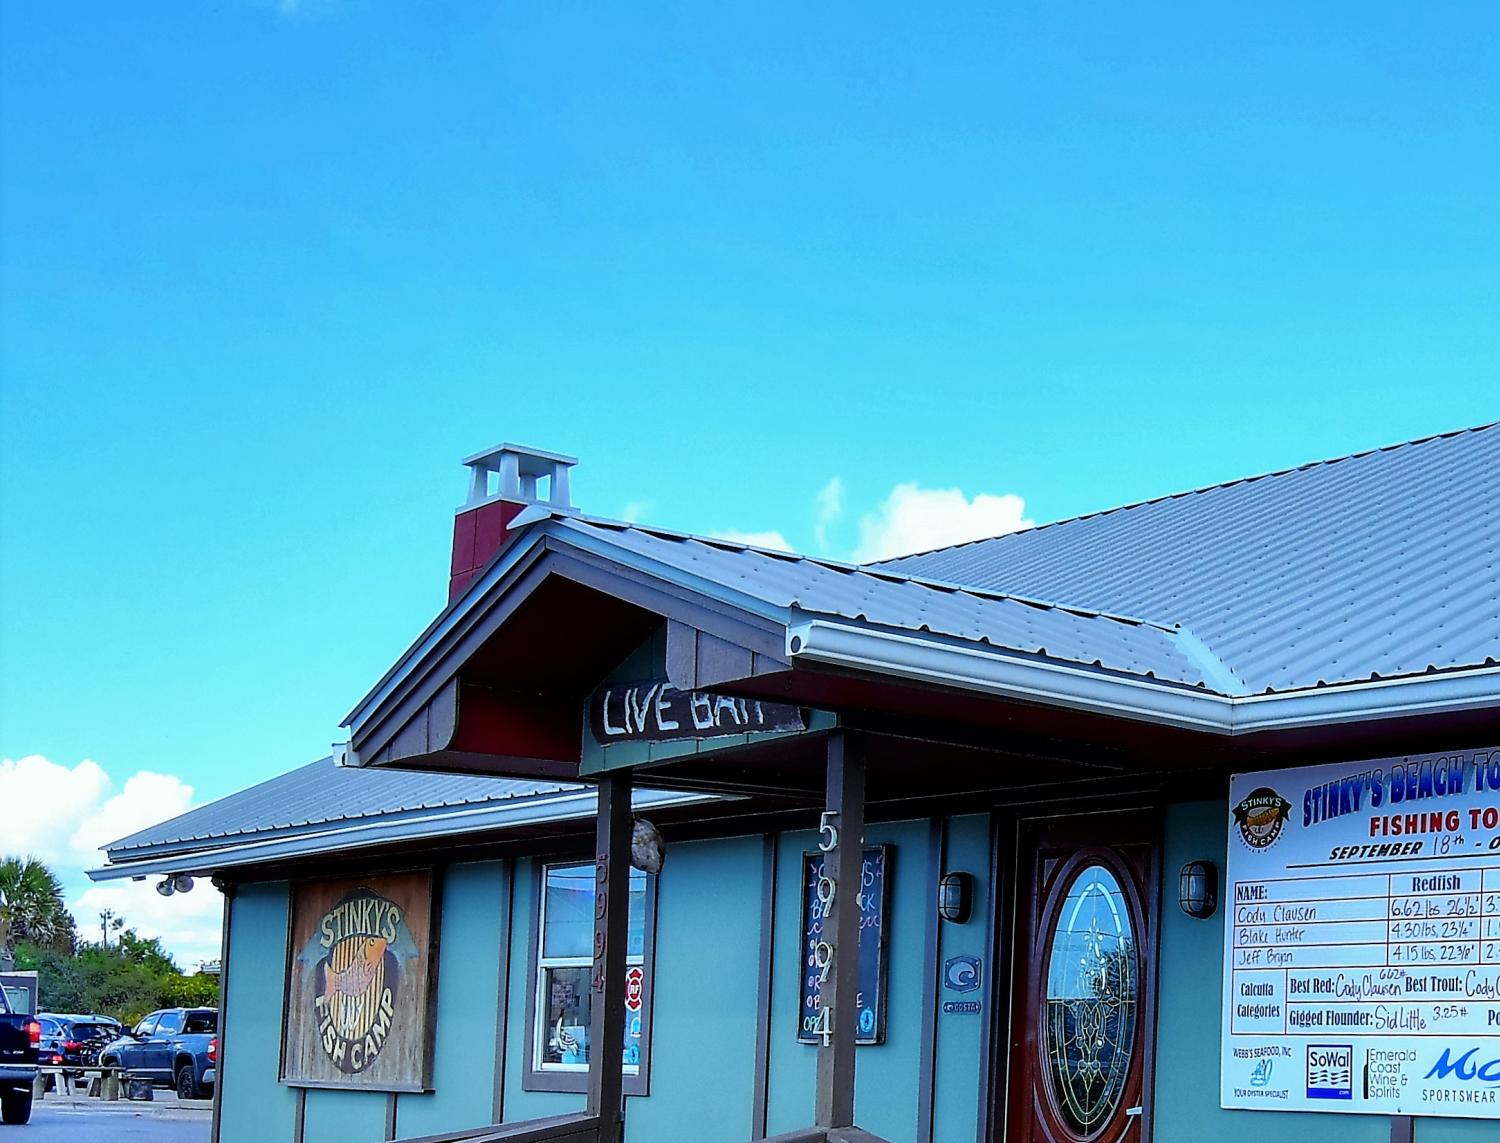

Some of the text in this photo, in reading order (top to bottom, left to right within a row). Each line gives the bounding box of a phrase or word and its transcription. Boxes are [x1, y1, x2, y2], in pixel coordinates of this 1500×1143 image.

[603, 682, 679, 735] LIVE
[1303, 769, 1384, 828] STINKY'S
[1391, 755, 1465, 804] BEACH
[1370, 810, 1460, 837] FISHING
[1329, 842, 1423, 860] SEPTEMBER
[1433, 835, 1465, 856] 18th
[1237, 886, 1268, 900] NAME:
[1412, 875, 1460, 892] Redfish
[319, 898, 400, 948] STINKY'S
[1238, 907, 1266, 924] Cody
[1239, 929, 1268, 945] Blake
[1239, 950, 1261, 966] Jeff
[1241, 983, 1274, 997] Calcutta
[1290, 979, 1335, 994] Best Red:
[1336, 973, 1362, 1001] Cody
[1405, 976, 1463, 992] Best Trout:
[1465, 969, 1495, 999] Cody
[954, 1003, 976, 1011] COSTA
[1237, 1003, 1280, 1019] Categories
[1289, 1009, 1373, 1028] Gigged Flounder:
[1375, 1005, 1399, 1030] Sid
[316, 987, 394, 1070] FISH CAMP
[1310, 1052, 1349, 1068] SoWal
[1370, 1049, 1416, 1061] Emerald
[1370, 1061, 1401, 1073] Coast
[1370, 1075, 1408, 1086] Wine &
[1370, 1086, 1401, 1099] Spirits
[1422, 1089, 1496, 1103] SPORTSWEAR
